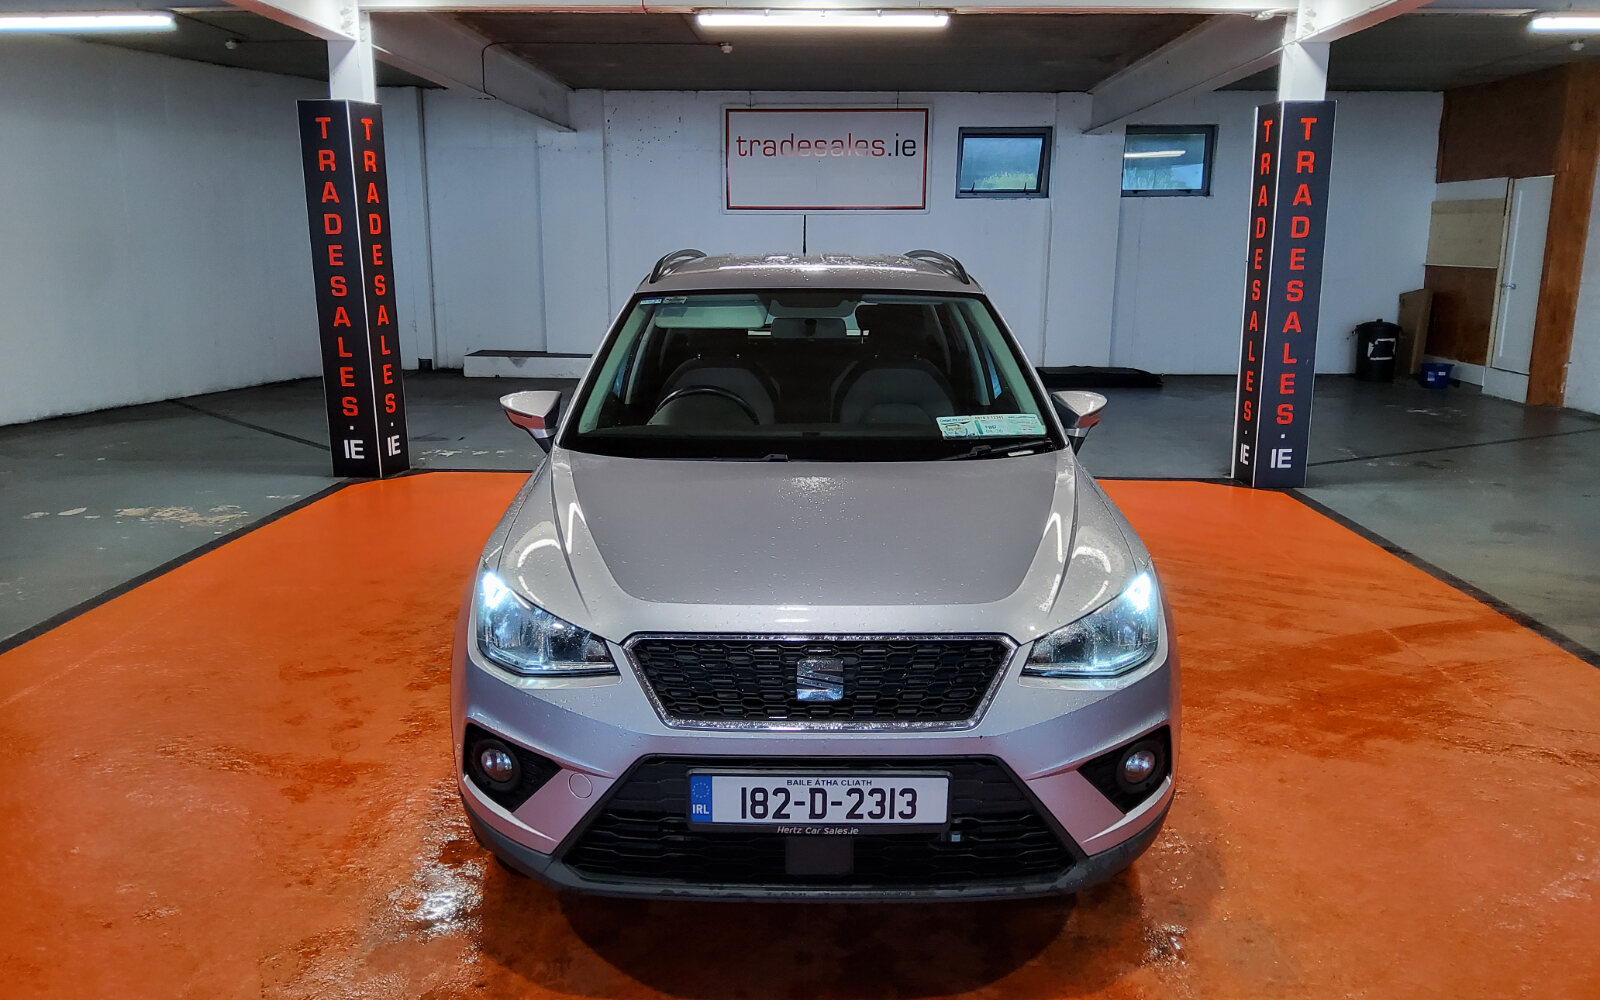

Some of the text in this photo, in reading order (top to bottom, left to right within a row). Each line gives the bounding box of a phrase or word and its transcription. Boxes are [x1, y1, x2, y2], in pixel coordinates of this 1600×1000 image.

[736, 133, 916, 157] tradesales.ie
[786, 778, 873, 787] BAILE ÁTHA CLIATH
[692, 804, 710, 814] IRL
[740, 787, 918, 820] 182-D-2313
[776, 825, 859, 836] Hertz Car Sales.ie
